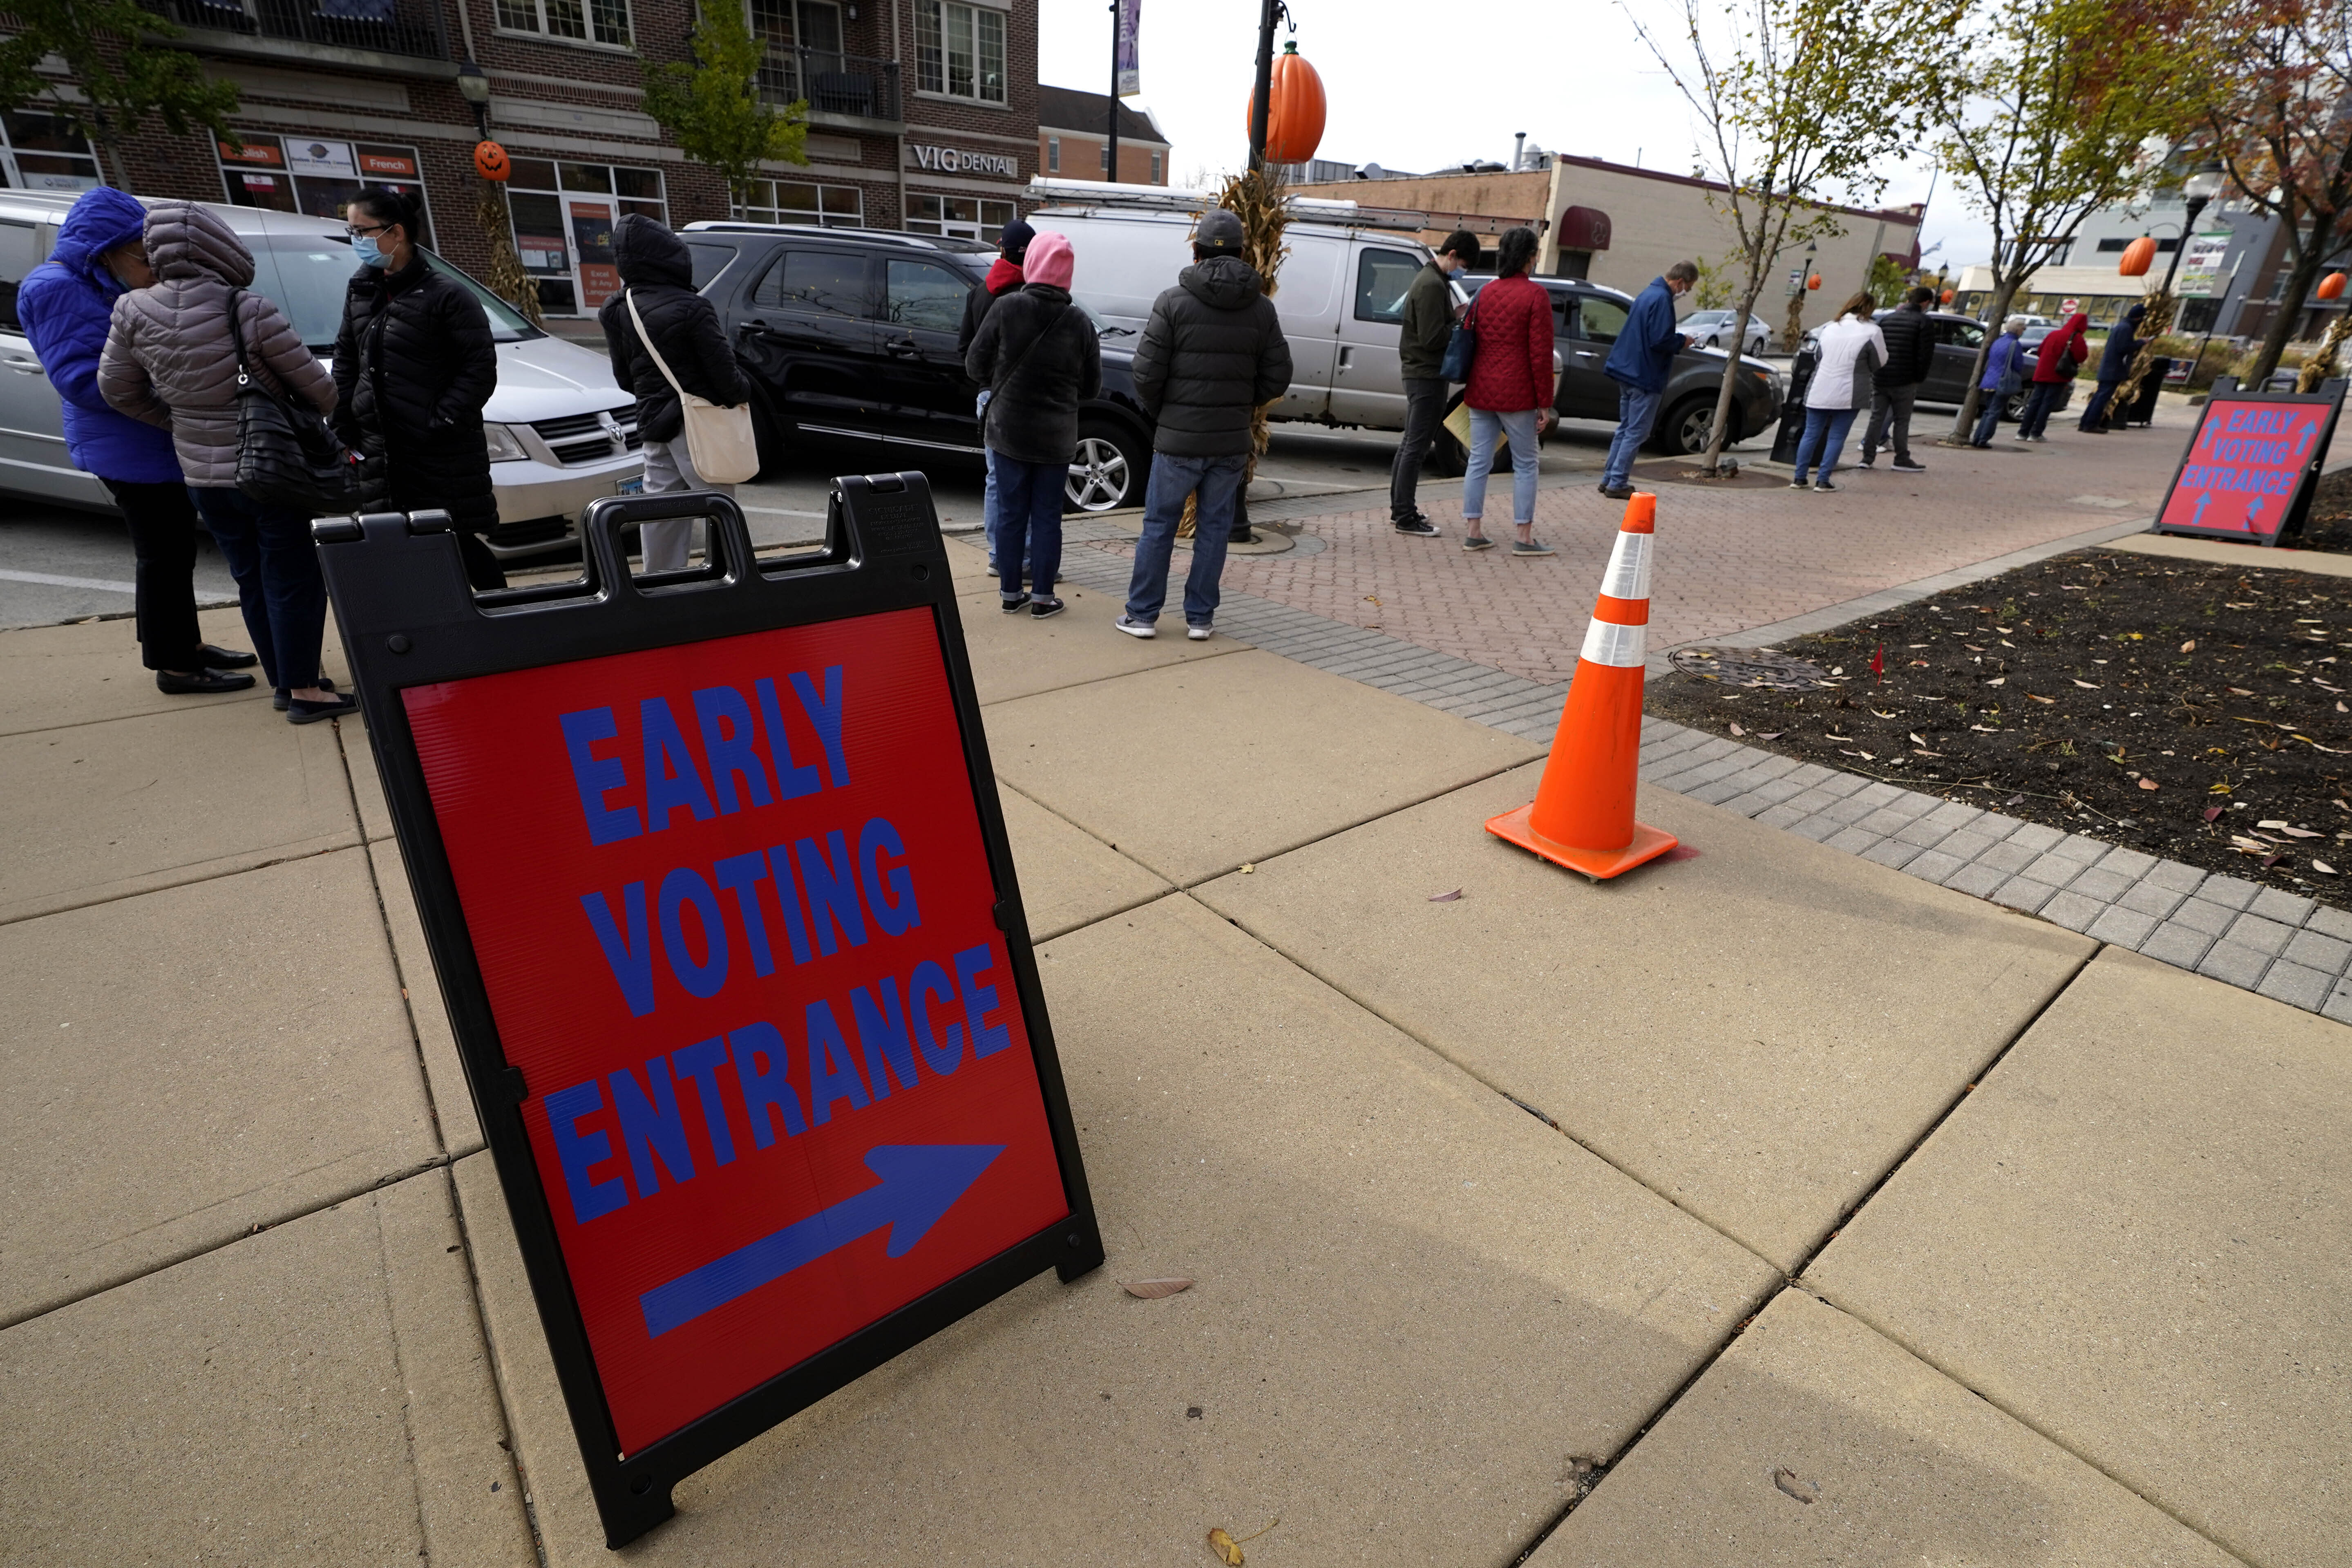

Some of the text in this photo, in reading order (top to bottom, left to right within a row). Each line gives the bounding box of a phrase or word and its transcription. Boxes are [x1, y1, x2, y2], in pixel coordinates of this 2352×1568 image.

[235, 147, 268, 159] olish
[369, 159, 405, 170] French
[913, 145, 1012, 174] VIG DENTAL
[2227, 410, 2299, 434] EARLY
[2213, 438, 2289, 464] VOTING
[2181, 465, 2295, 495] ENTRANCE
[560, 665, 850, 846] EARLY
[580, 817, 921, 1017] VOTING
[544, 943, 1011, 1224] ENTRANCE
